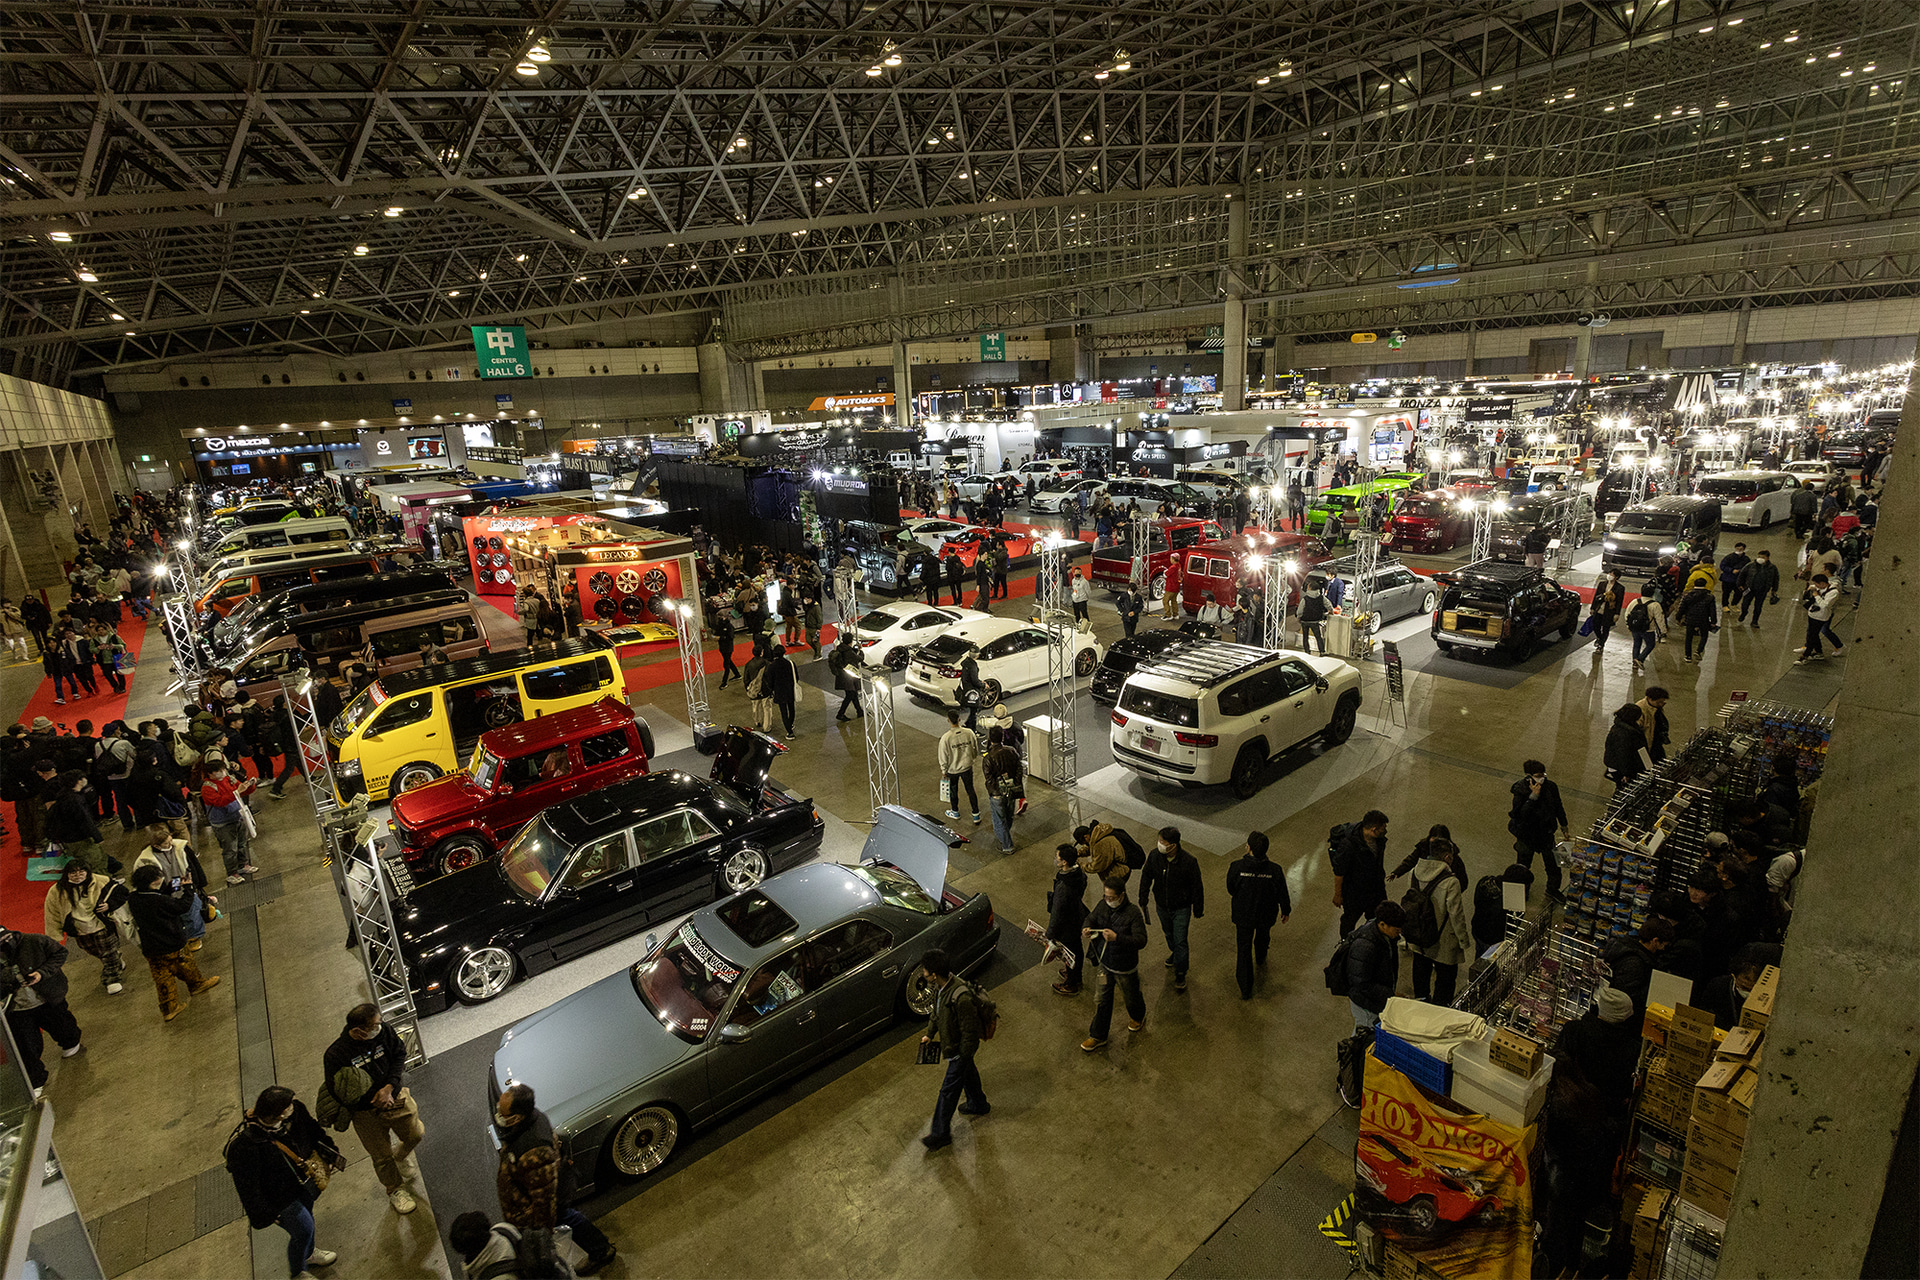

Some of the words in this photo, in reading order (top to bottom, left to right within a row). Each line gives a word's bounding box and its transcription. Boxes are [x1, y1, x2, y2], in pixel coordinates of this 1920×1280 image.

[486, 327, 515, 356] 中
[997, 351, 1003, 360] 5
[486, 368, 513, 377] HALL
[514, 364, 525, 376] 6
[836, 396, 886, 406] AUTOBACS
[1399, 399, 1442, 408] MONZA
[226, 438, 271, 447] mazda
[563, 457, 583, 471] BLAST
[588, 459, 609, 473] TRAIL
[694, 939, 713, 961] BODY
[710, 955, 740, 981] WORKS
[1361, 1092, 1419, 1137] HOT
